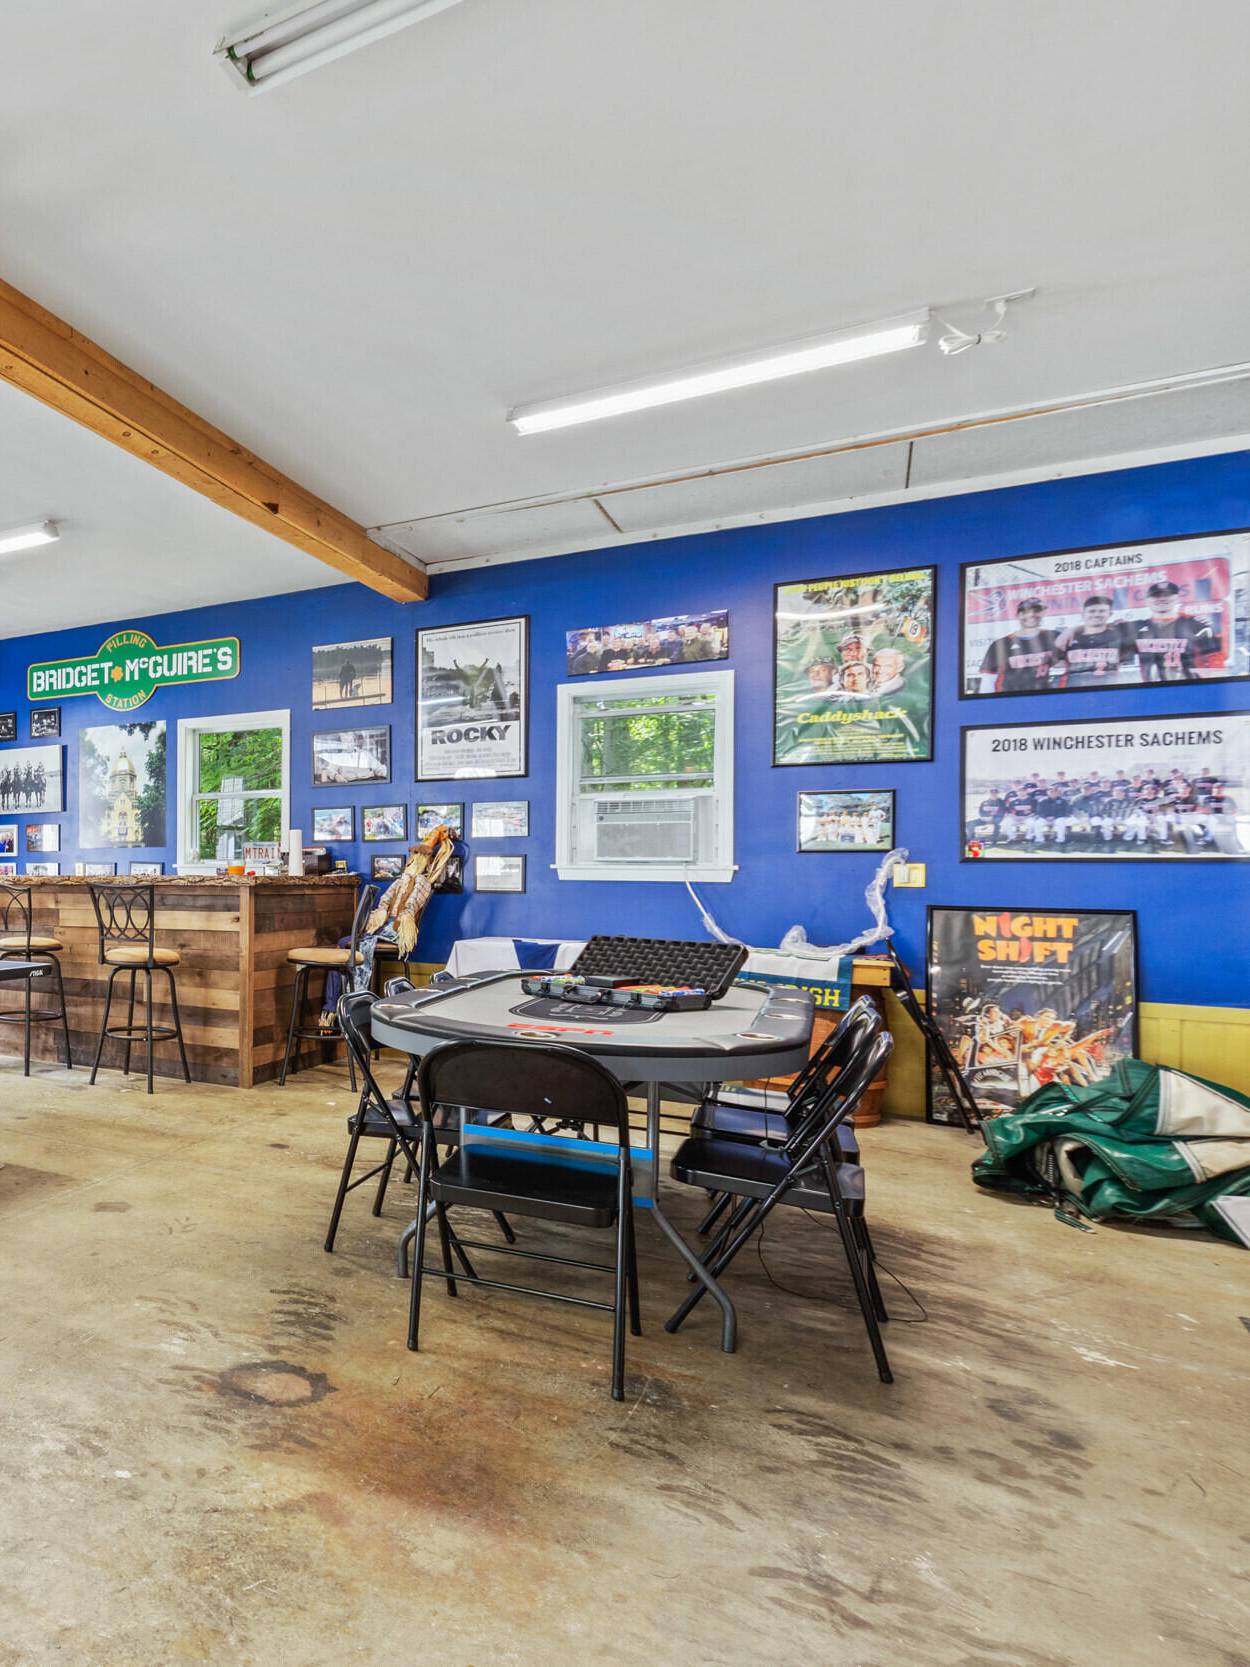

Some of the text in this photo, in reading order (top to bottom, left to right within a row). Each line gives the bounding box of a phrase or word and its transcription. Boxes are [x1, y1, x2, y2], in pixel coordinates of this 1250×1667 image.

[1054, 553, 1143, 573] 2018 CAPTAINS
[1010, 570, 1168, 600] WINCHESTER SACHEMS
[106, 634, 148, 653] FILLING
[32, 661, 114, 693] BRIDGET
[105, 689, 147, 708] STATION
[797, 706, 908, 724] Caddyshack
[431, 725, 511, 745] ROCKY
[991, 730, 1223, 753] 2018 WINCHESTER SACHEMS
[973, 912, 1079, 938] NIGHT
[976, 937, 1073, 963] SHIFT
[506, 1022, 615, 1035] ESPN
